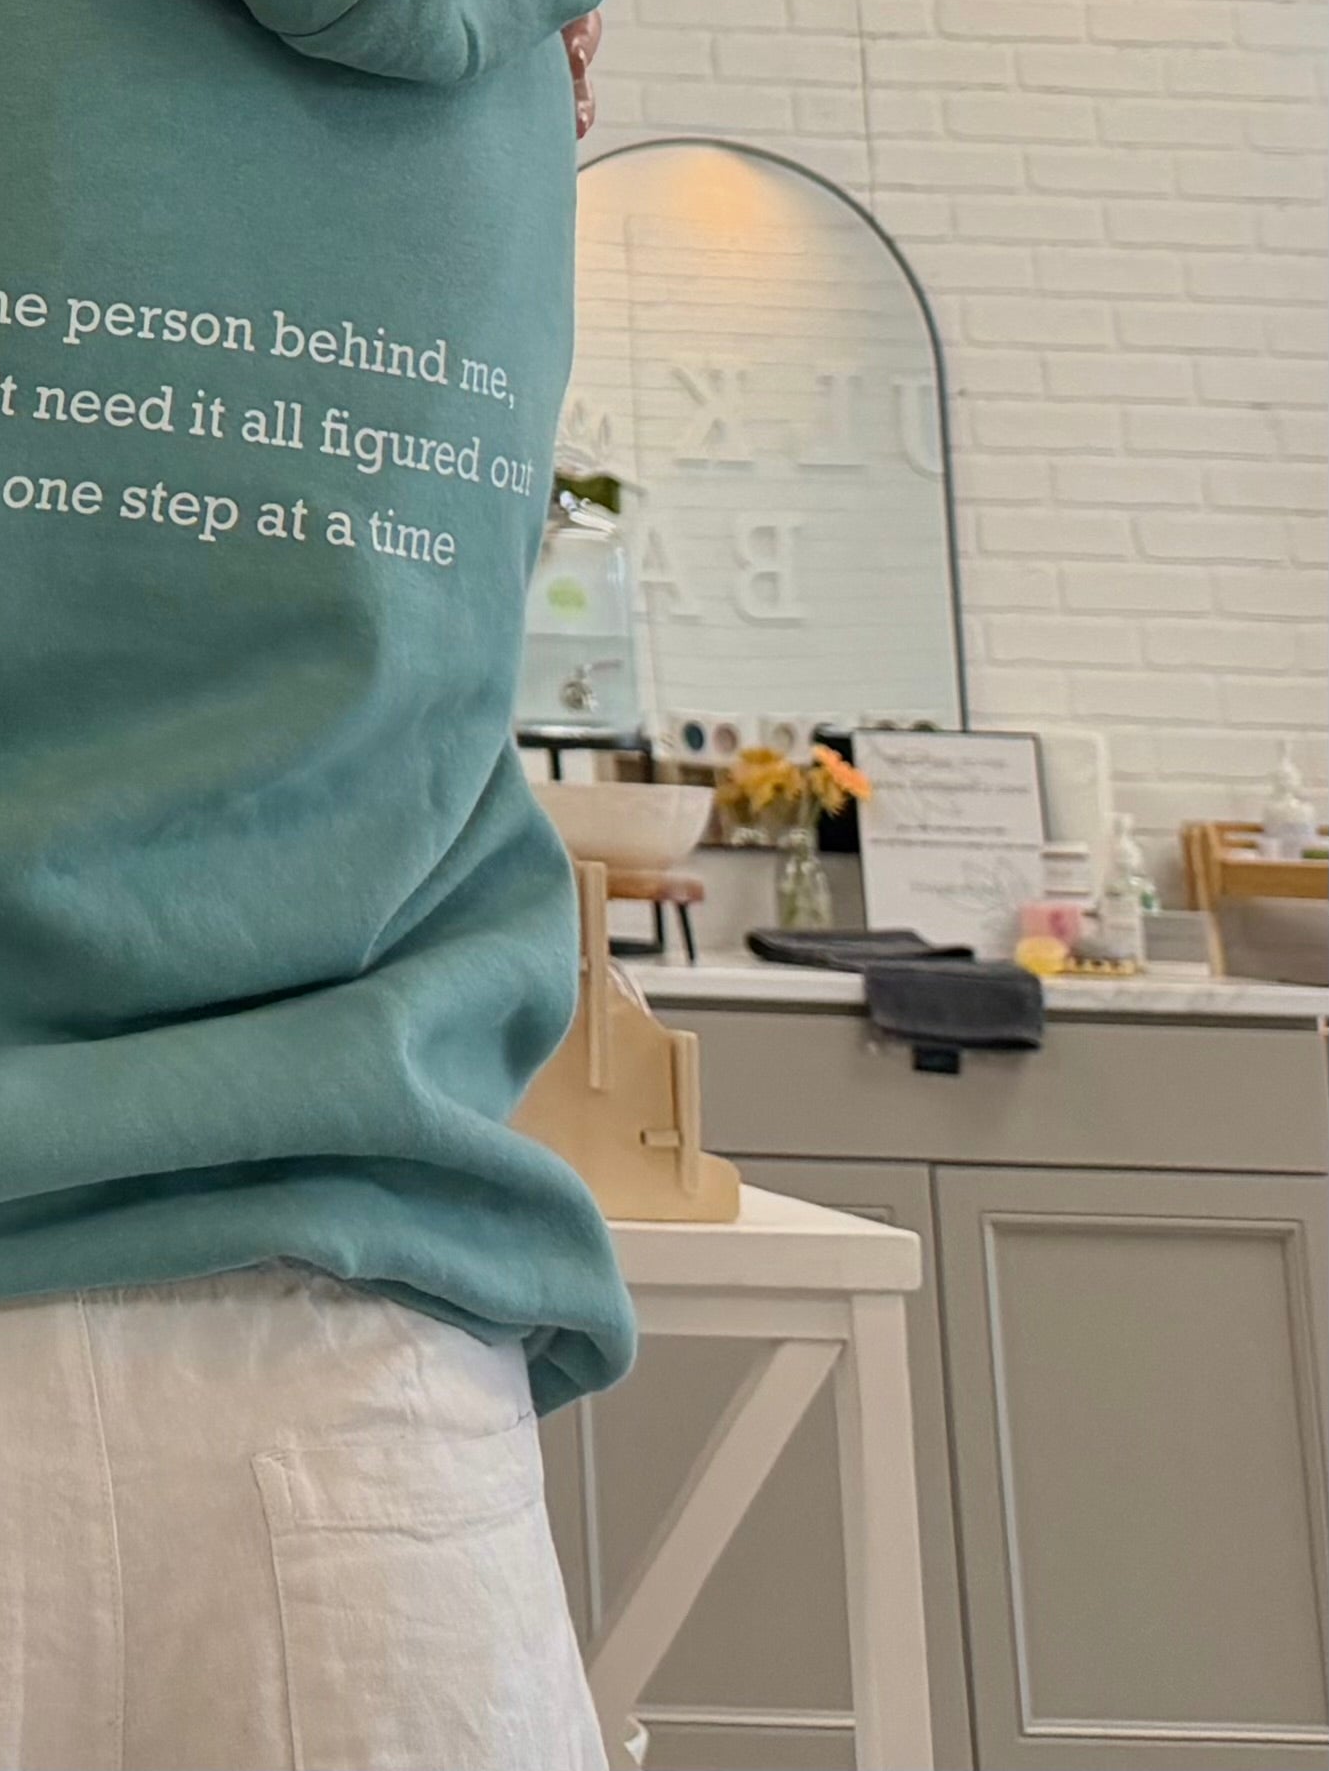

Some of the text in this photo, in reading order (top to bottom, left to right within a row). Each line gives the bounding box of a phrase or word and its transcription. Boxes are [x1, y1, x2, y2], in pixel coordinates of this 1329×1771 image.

[62, 298, 256, 353] person
[269, 309, 449, 386] behind
[459, 358, 515, 410] me,
[32, 385, 175, 433] need
[188, 388, 226, 439] it
[241, 400, 304, 450] all
[319, 407, 481, 483] figured
[490, 454, 535, 498] out
[2, 475, 104, 515] one
[119, 481, 239, 543] step
[256, 498, 309, 542] at
[325, 511, 356, 548] a
[368, 507, 456, 566] time
